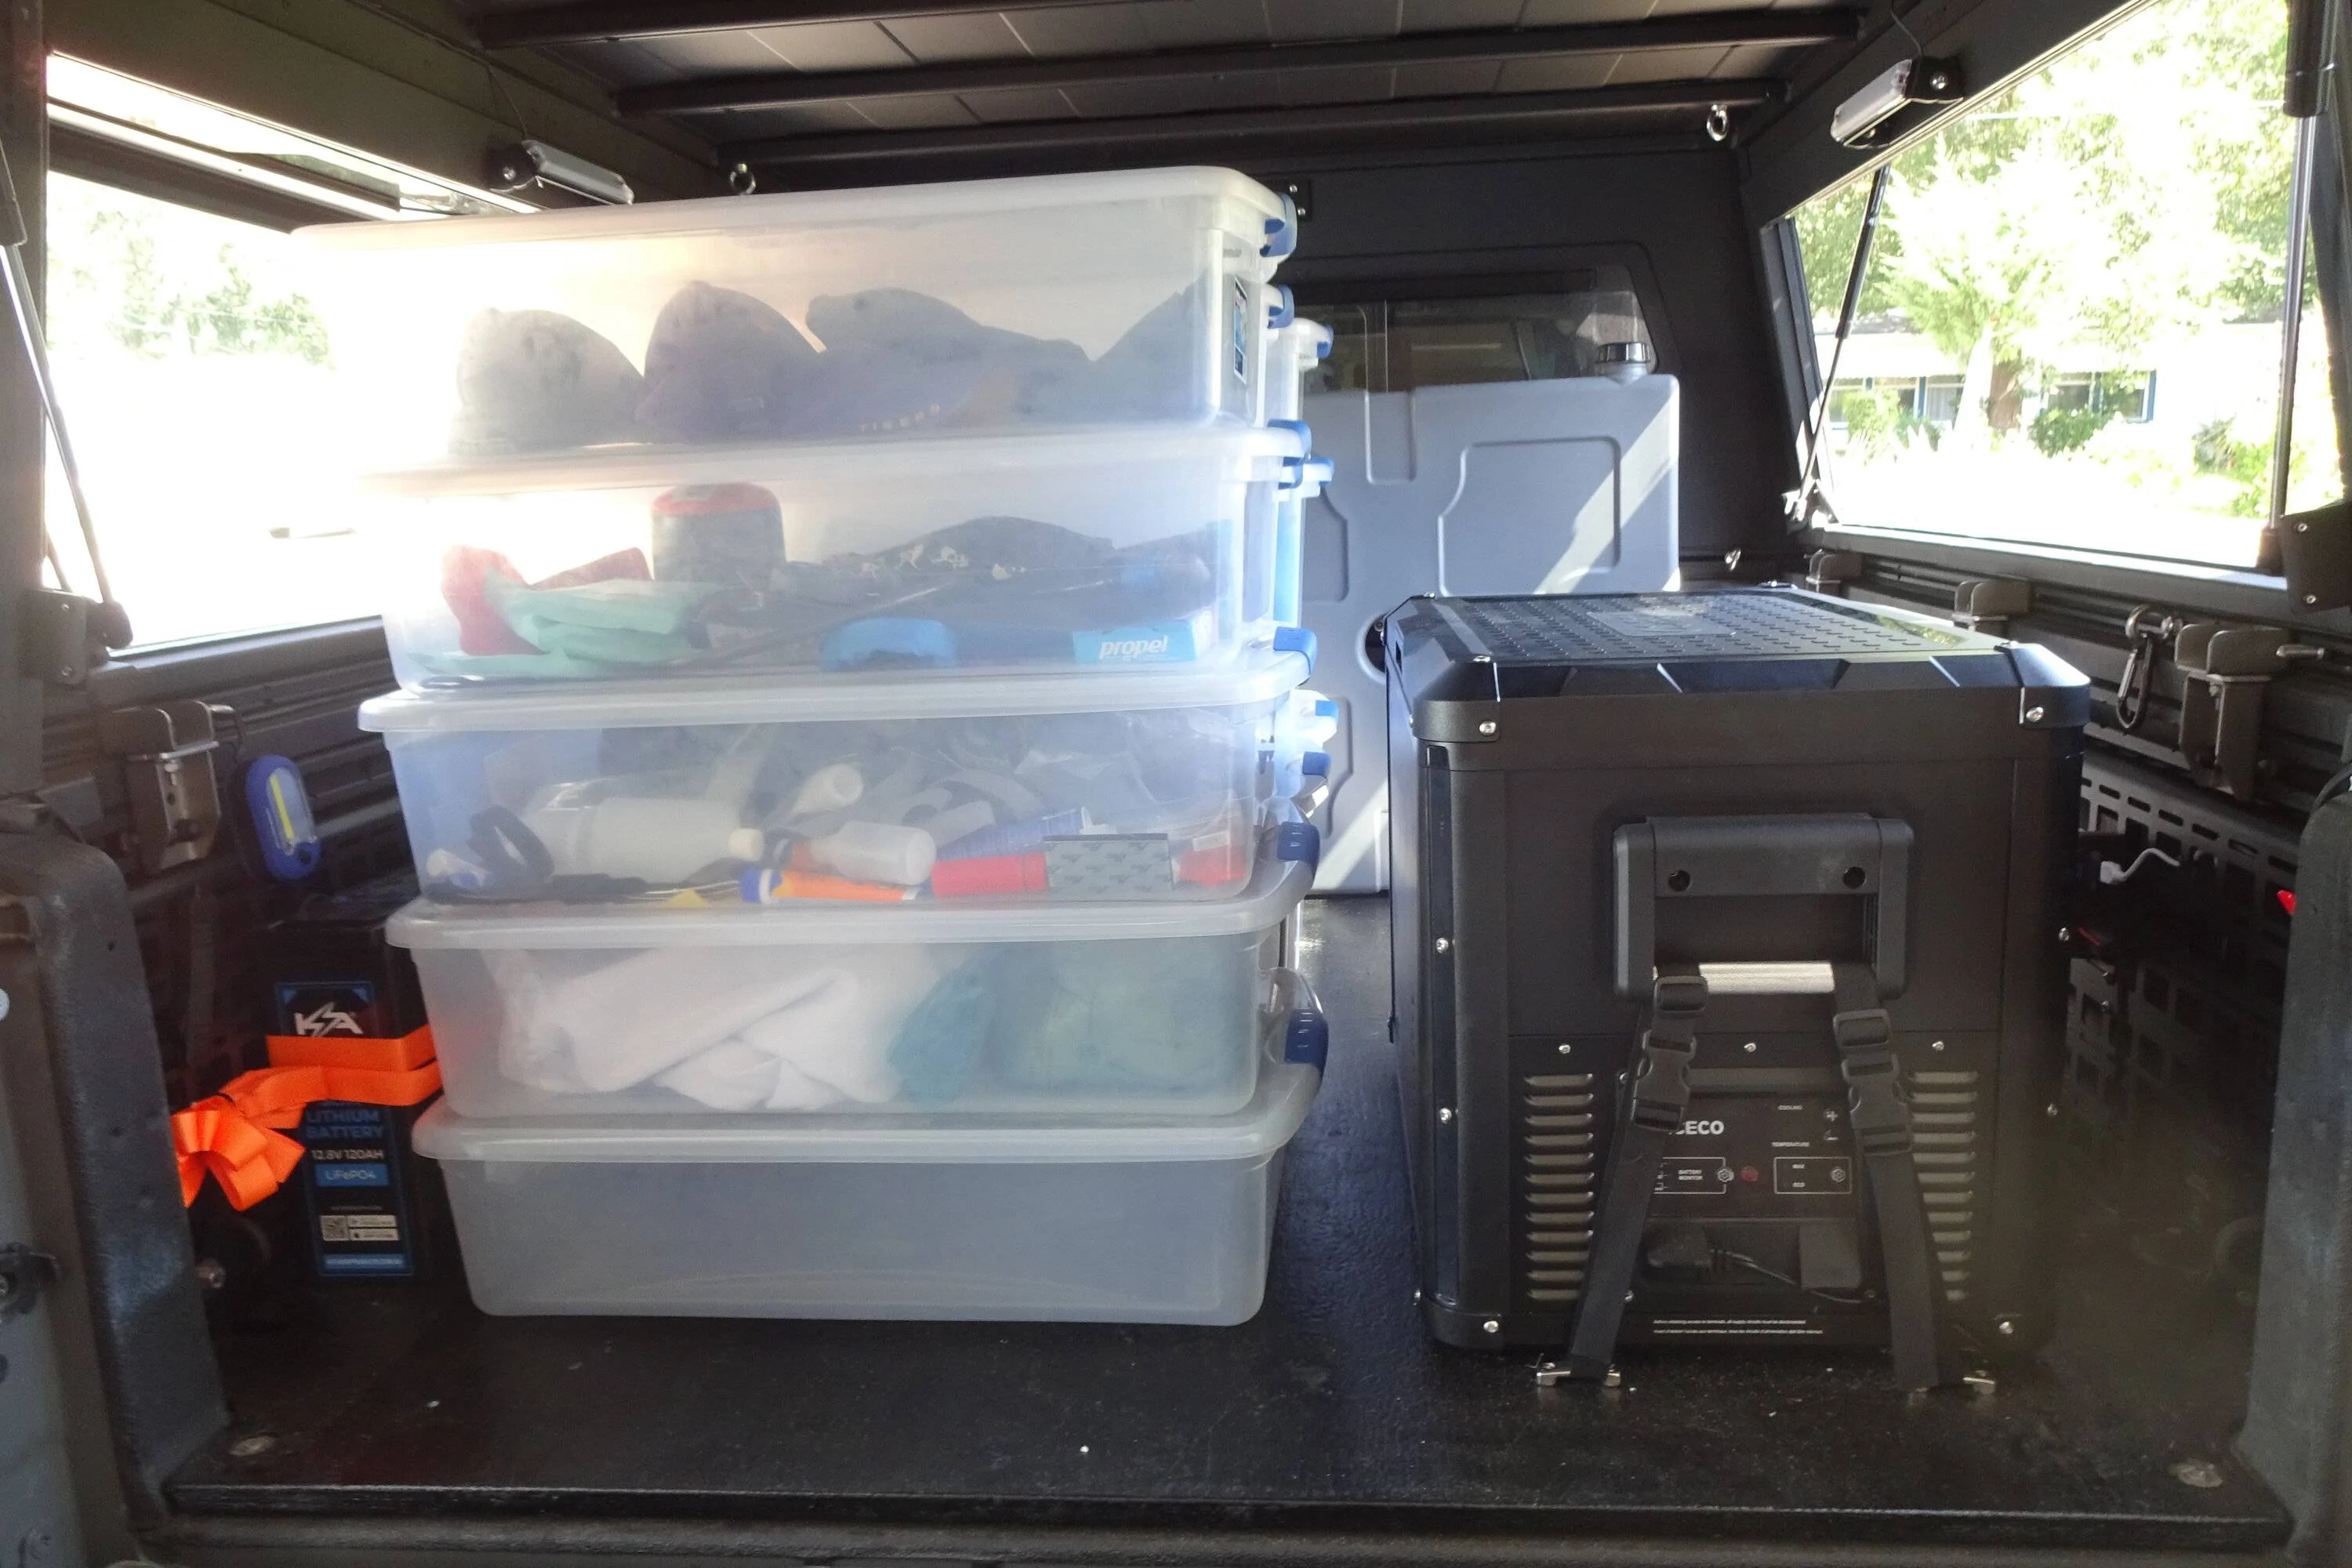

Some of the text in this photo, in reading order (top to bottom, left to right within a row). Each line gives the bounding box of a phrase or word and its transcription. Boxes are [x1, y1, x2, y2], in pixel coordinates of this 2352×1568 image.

[1099, 635, 1168, 660] propel
[307, 1109, 379, 1123] LITHIUM
[307, 1125, 383, 1138] BATTERY
